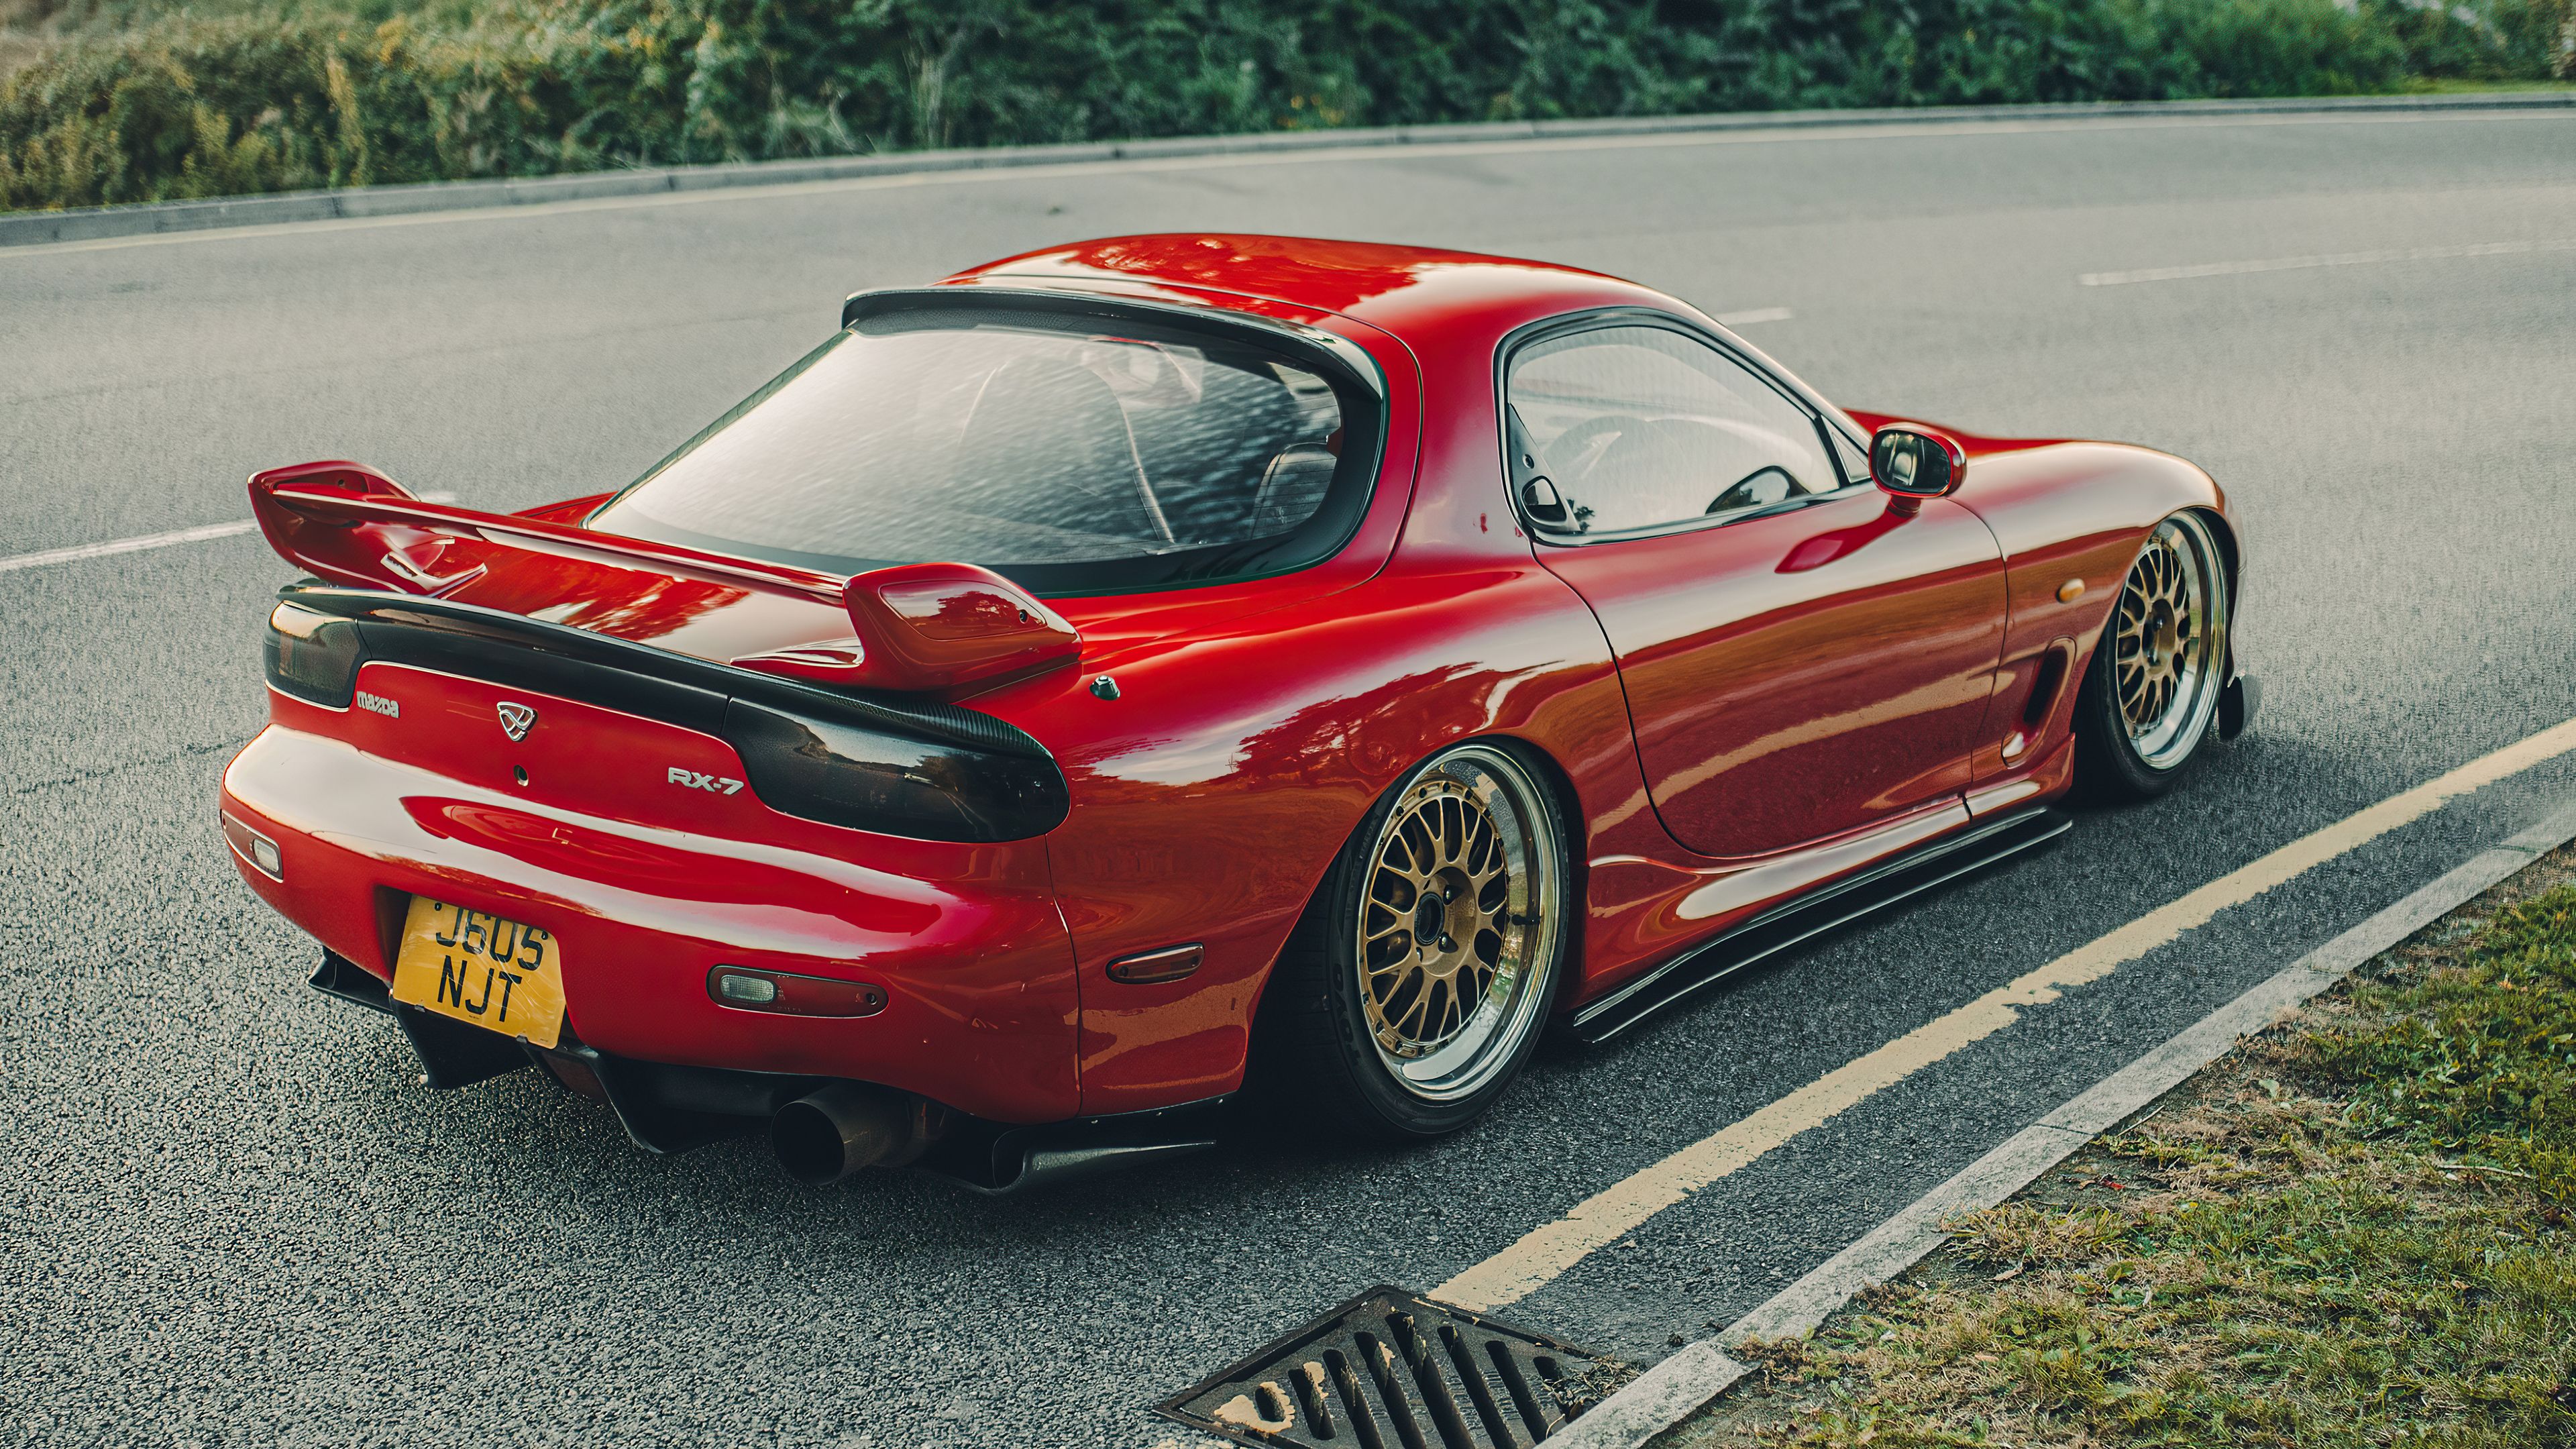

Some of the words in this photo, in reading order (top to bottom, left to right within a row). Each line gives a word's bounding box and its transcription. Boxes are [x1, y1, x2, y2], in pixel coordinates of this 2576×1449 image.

[356, 691, 400, 718] mazda
[668, 767, 745, 795] RX-7
[436, 907, 543, 971] J605
[437, 955, 523, 1022] NJT
